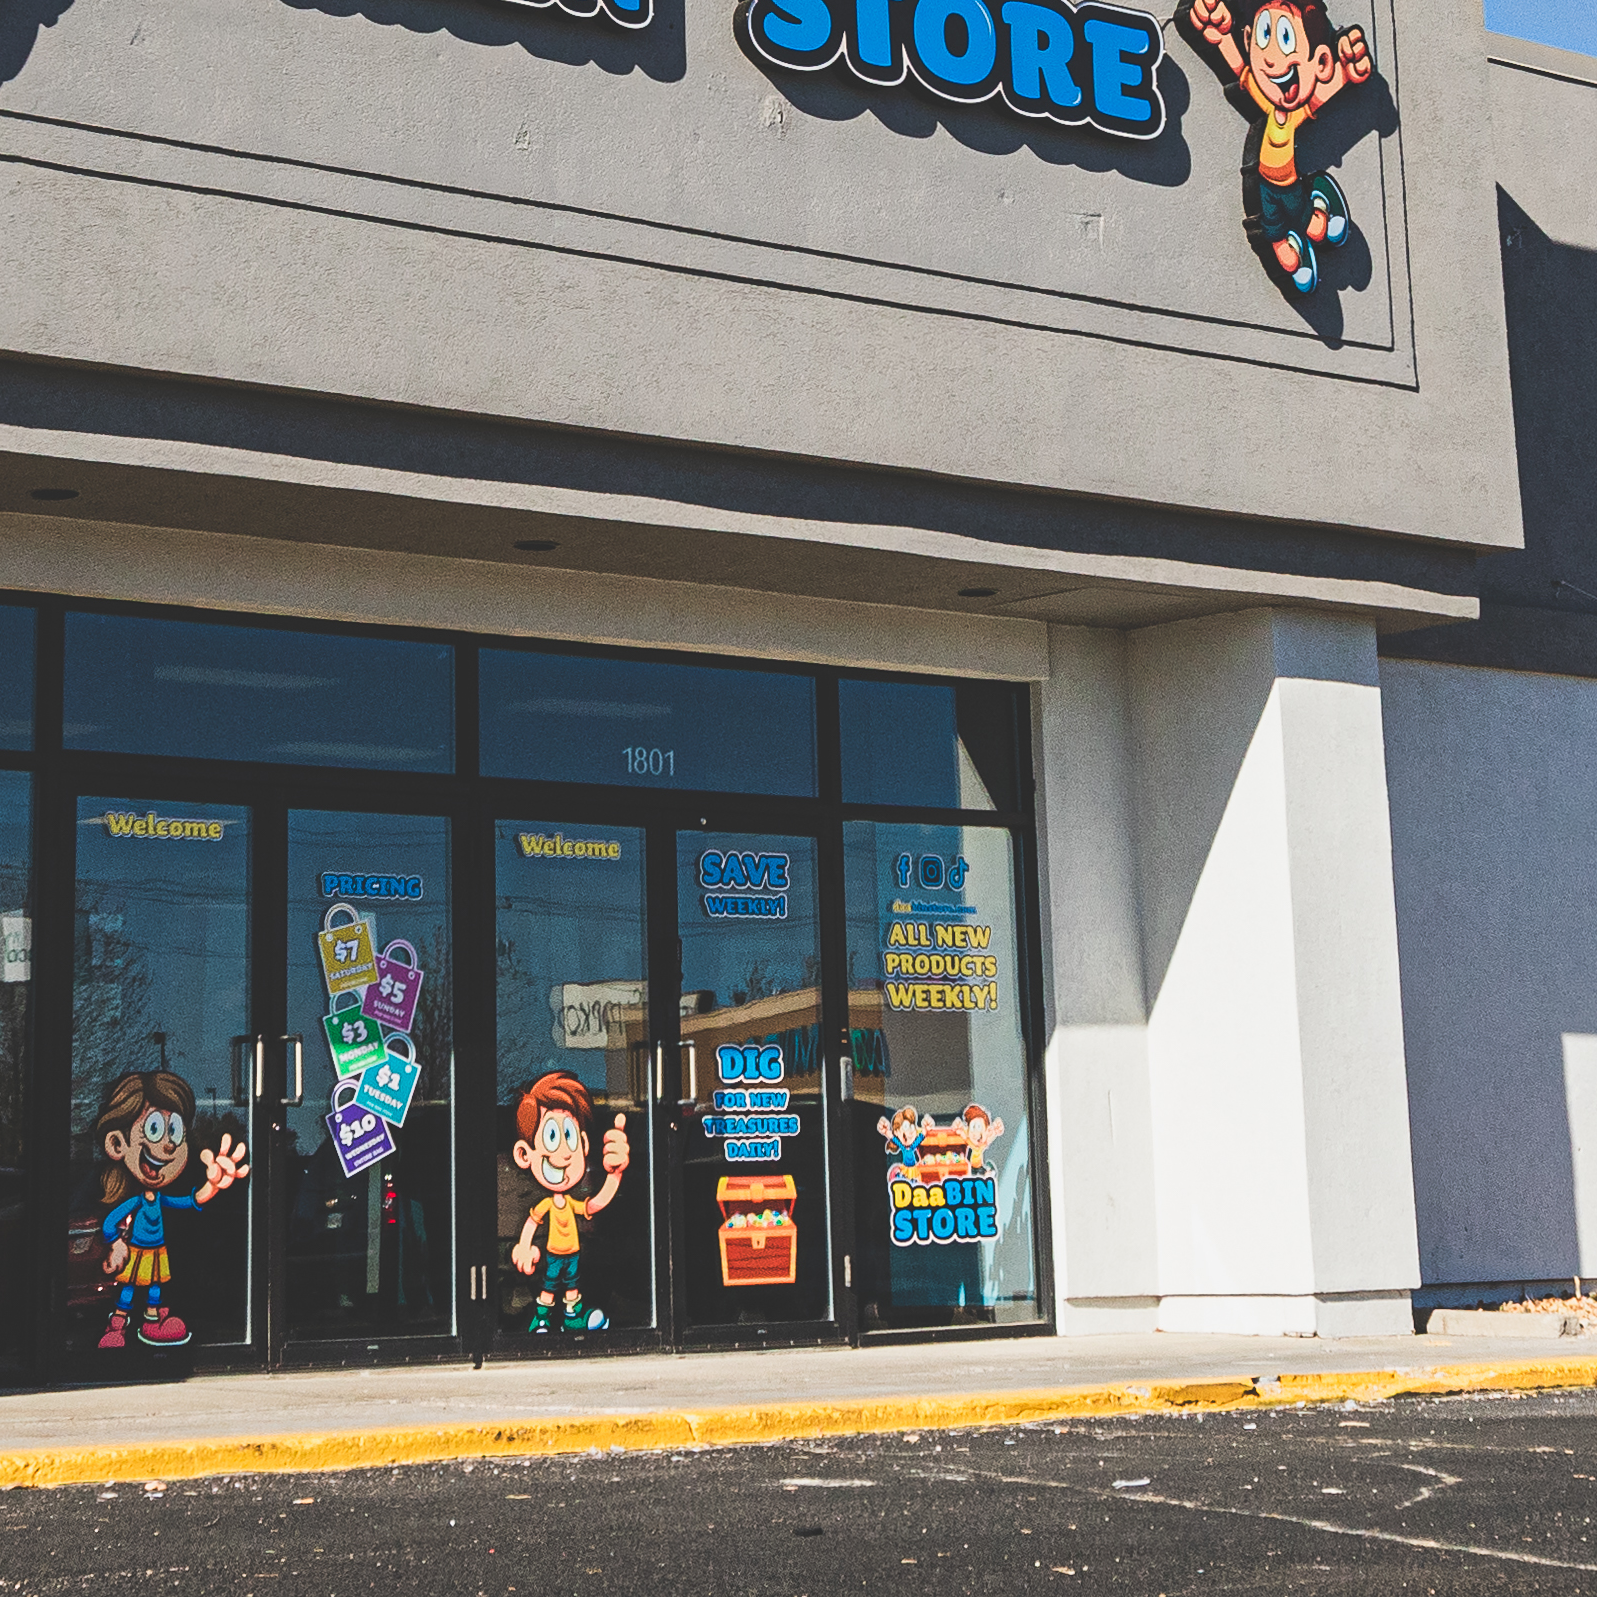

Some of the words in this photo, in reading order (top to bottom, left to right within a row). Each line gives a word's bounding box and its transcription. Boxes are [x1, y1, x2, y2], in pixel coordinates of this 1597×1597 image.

[622, 746, 674, 777] 1801
[106, 813, 222, 838] Welcome
[519, 833, 620, 858] Welcome
[703, 854, 786, 886] SAVE
[323, 875, 421, 898] PRICING
[707, 897, 785, 915] WEEKLY!
[889, 923, 931, 946] ALL
[934, 924, 992, 949] NEW
[334, 939, 359, 963] $7
[328, 962, 373, 981] SATURDAY
[885, 953, 997, 977] PRODUCTS
[378, 973, 407, 1004] $5
[886, 981, 998, 1010] WEEKLY!
[373, 999, 405, 1018] SUNDAY
[341, 1019, 368, 1045] $3
[338, 1041, 379, 1064] MONDAY
[718, 1048, 782, 1080] DIG
[375, 1064, 401, 1092] $1
[363, 1084, 404, 1110] TUESDAY
[714, 1092, 747, 1109] FOR
[748, 1092, 788, 1108] NEW
[339, 1113, 377, 1147] $10
[703, 1116, 799, 1135] TREASURES
[344, 1132, 385, 1161] WEDNESDAY
[726, 1139, 780, 1159] DAILY!
[892, 1179, 994, 1208] DaaBIN
[894, 1206, 997, 1240] STORE
